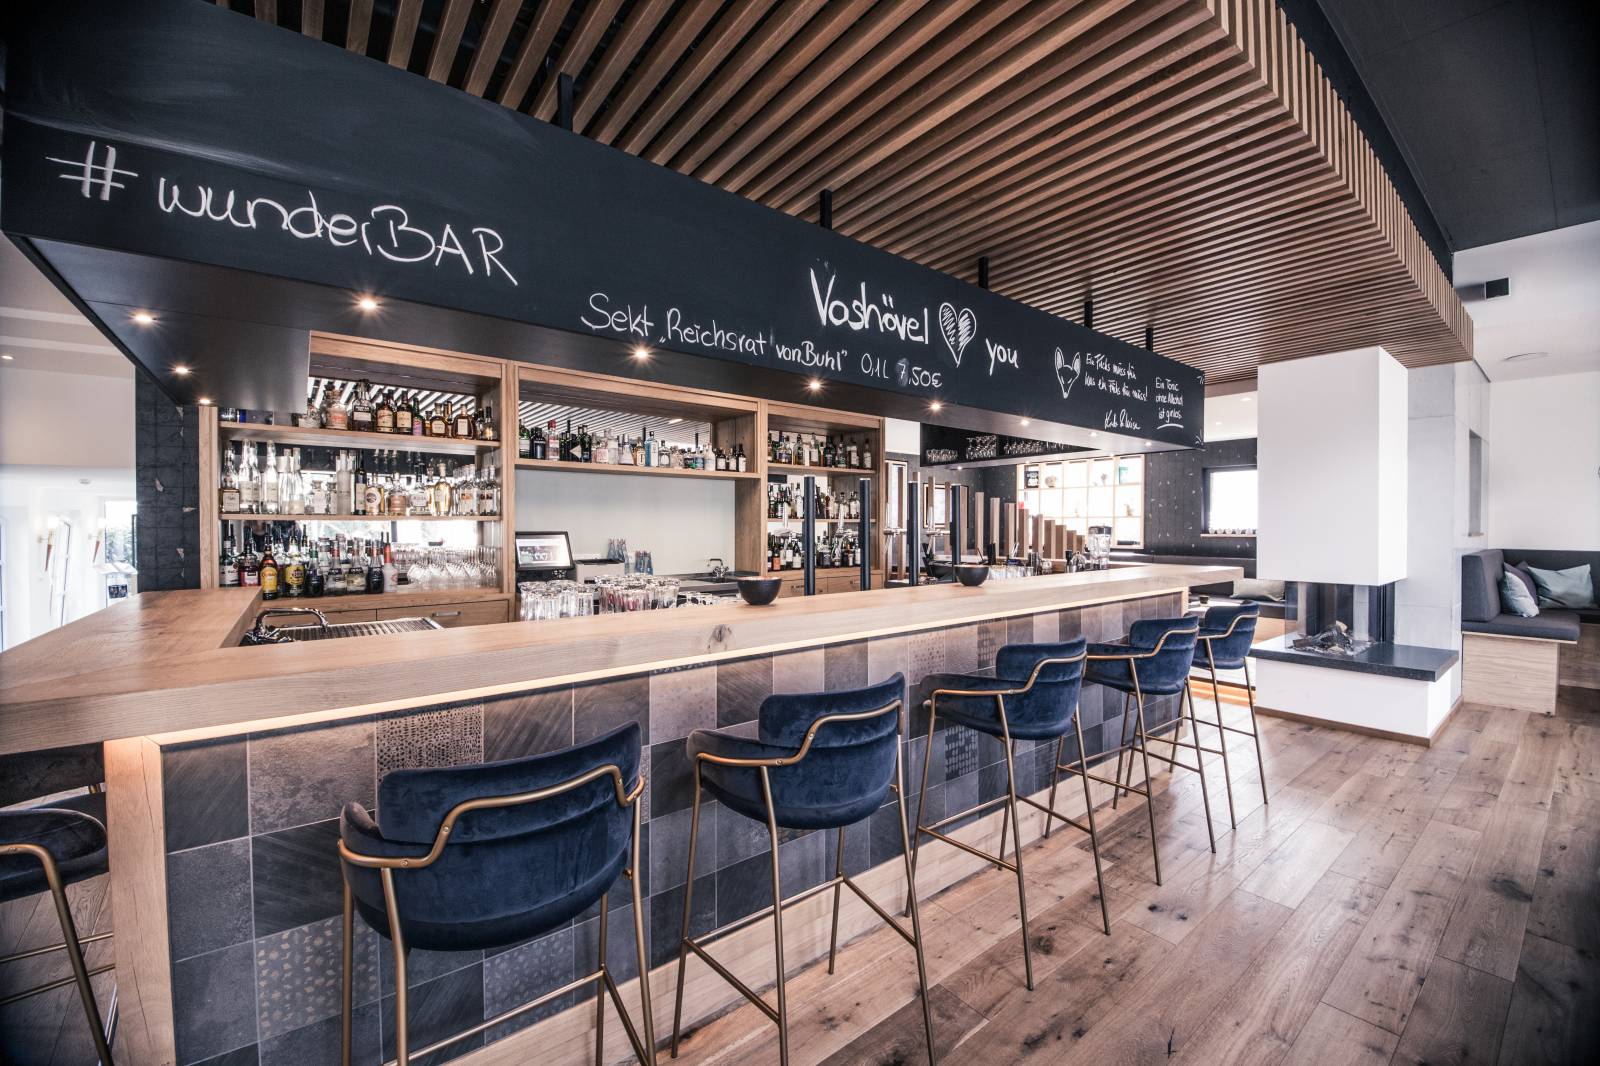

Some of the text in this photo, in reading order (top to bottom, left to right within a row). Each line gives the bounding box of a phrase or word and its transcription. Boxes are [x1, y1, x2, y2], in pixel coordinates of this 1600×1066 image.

[580, 292, 654, 337] Sekt
[810, 268, 1019, 376] Voshövel you
